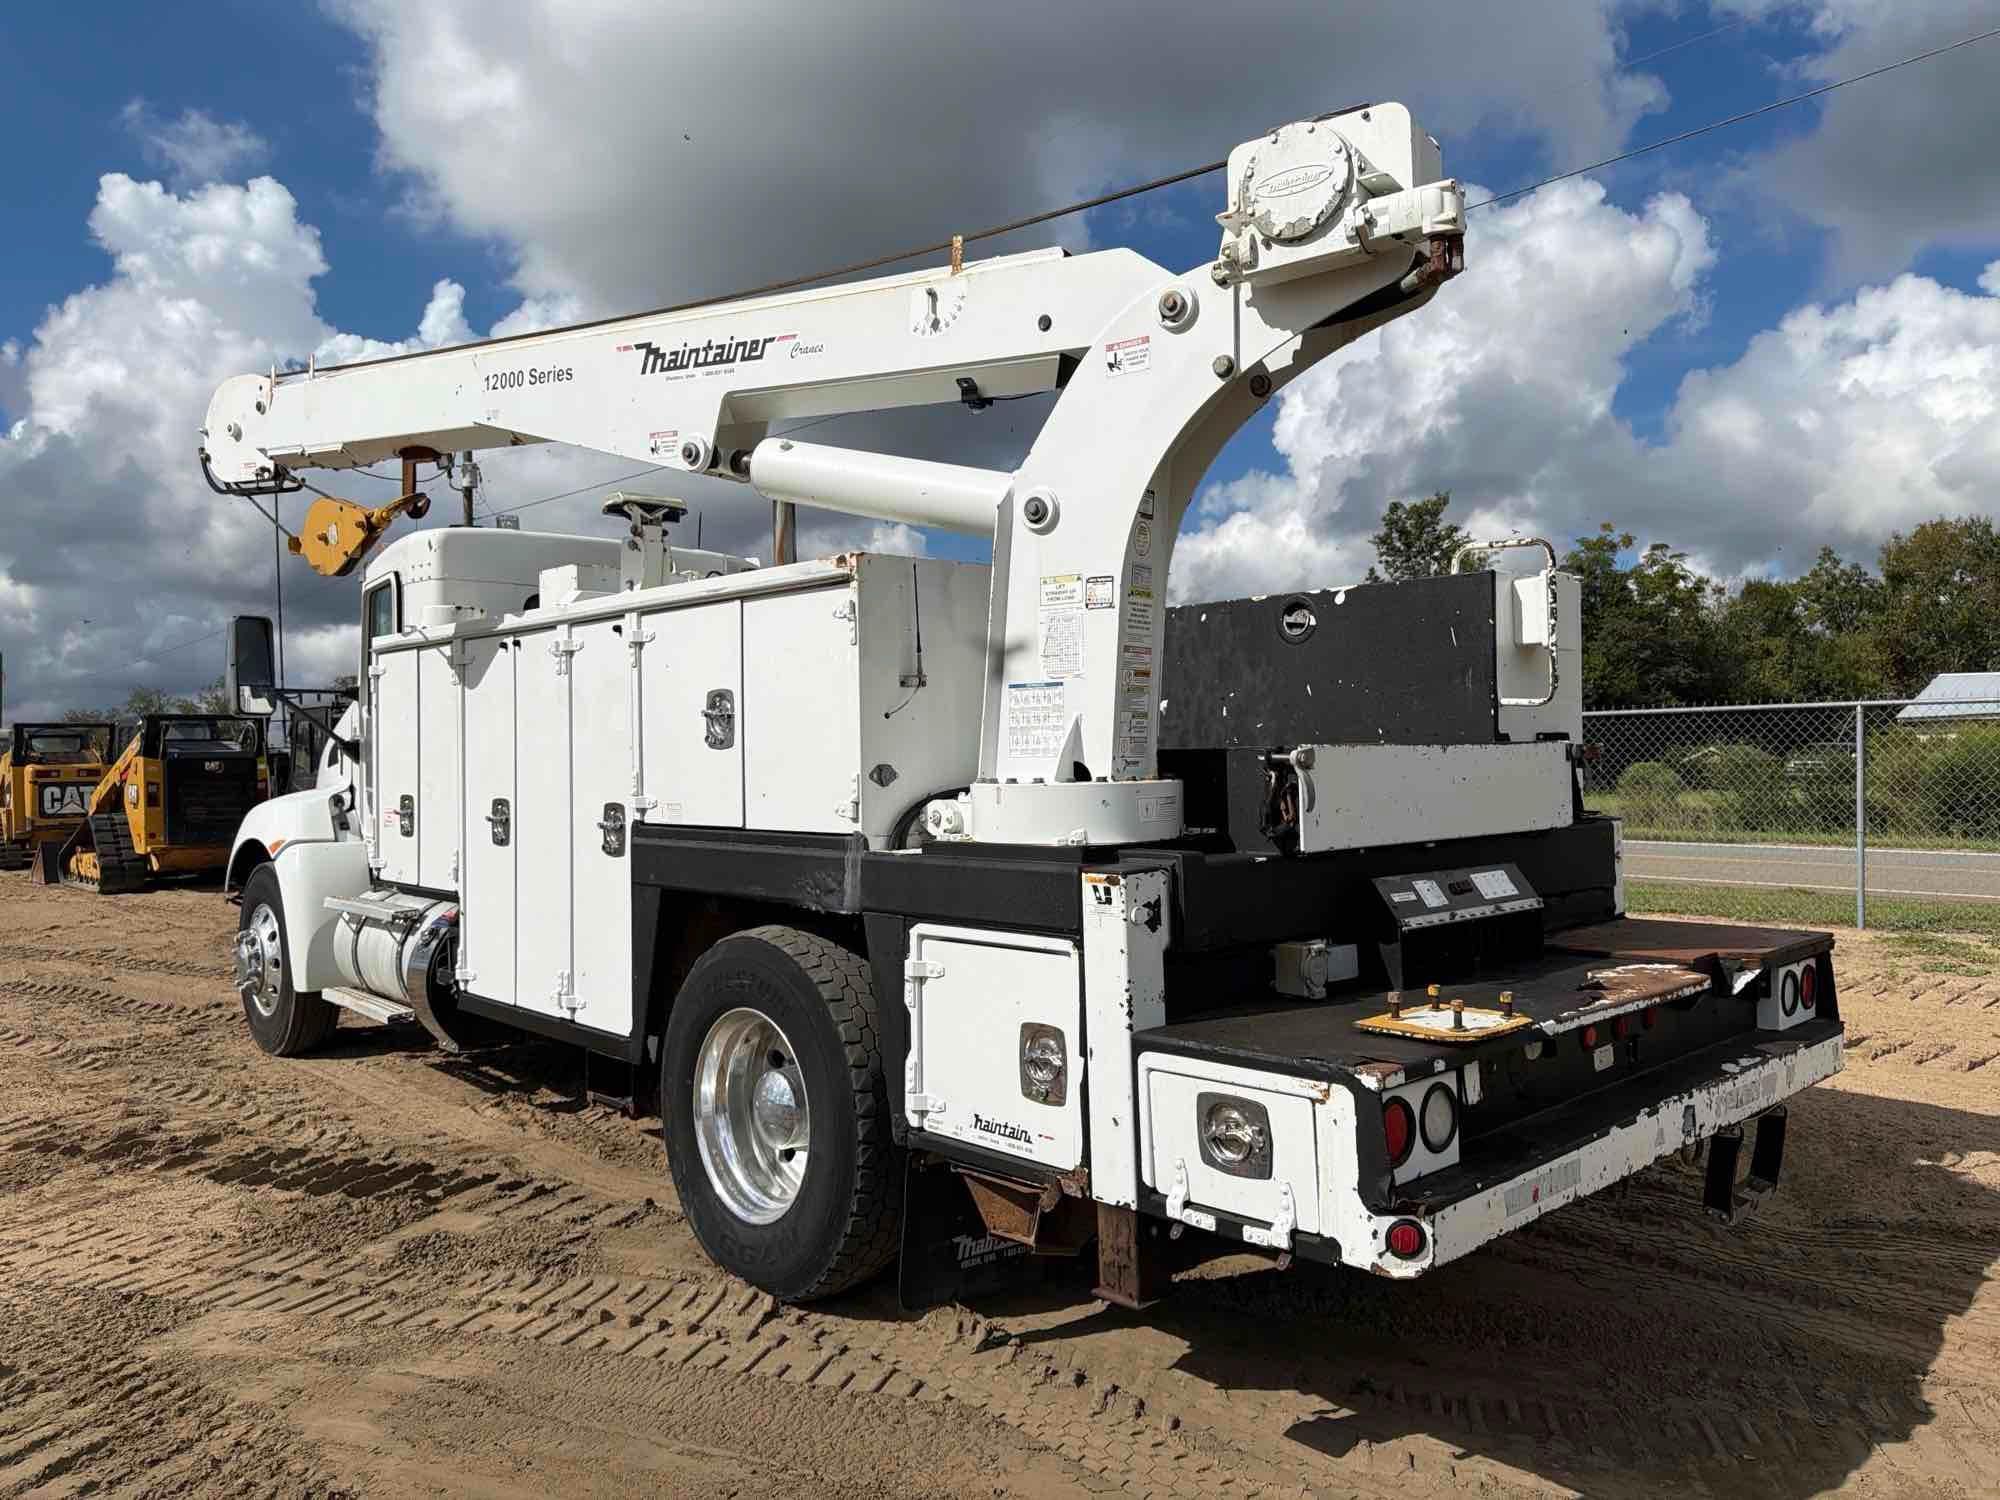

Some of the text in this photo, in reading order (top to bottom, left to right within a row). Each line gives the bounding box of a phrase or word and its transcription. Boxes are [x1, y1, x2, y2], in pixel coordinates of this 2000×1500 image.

[634, 335, 776, 375] Maintainer
[790, 341, 824, 359] Cranes
[484, 364, 573, 391] 12000 Series
[43, 785, 96, 815] CAT
